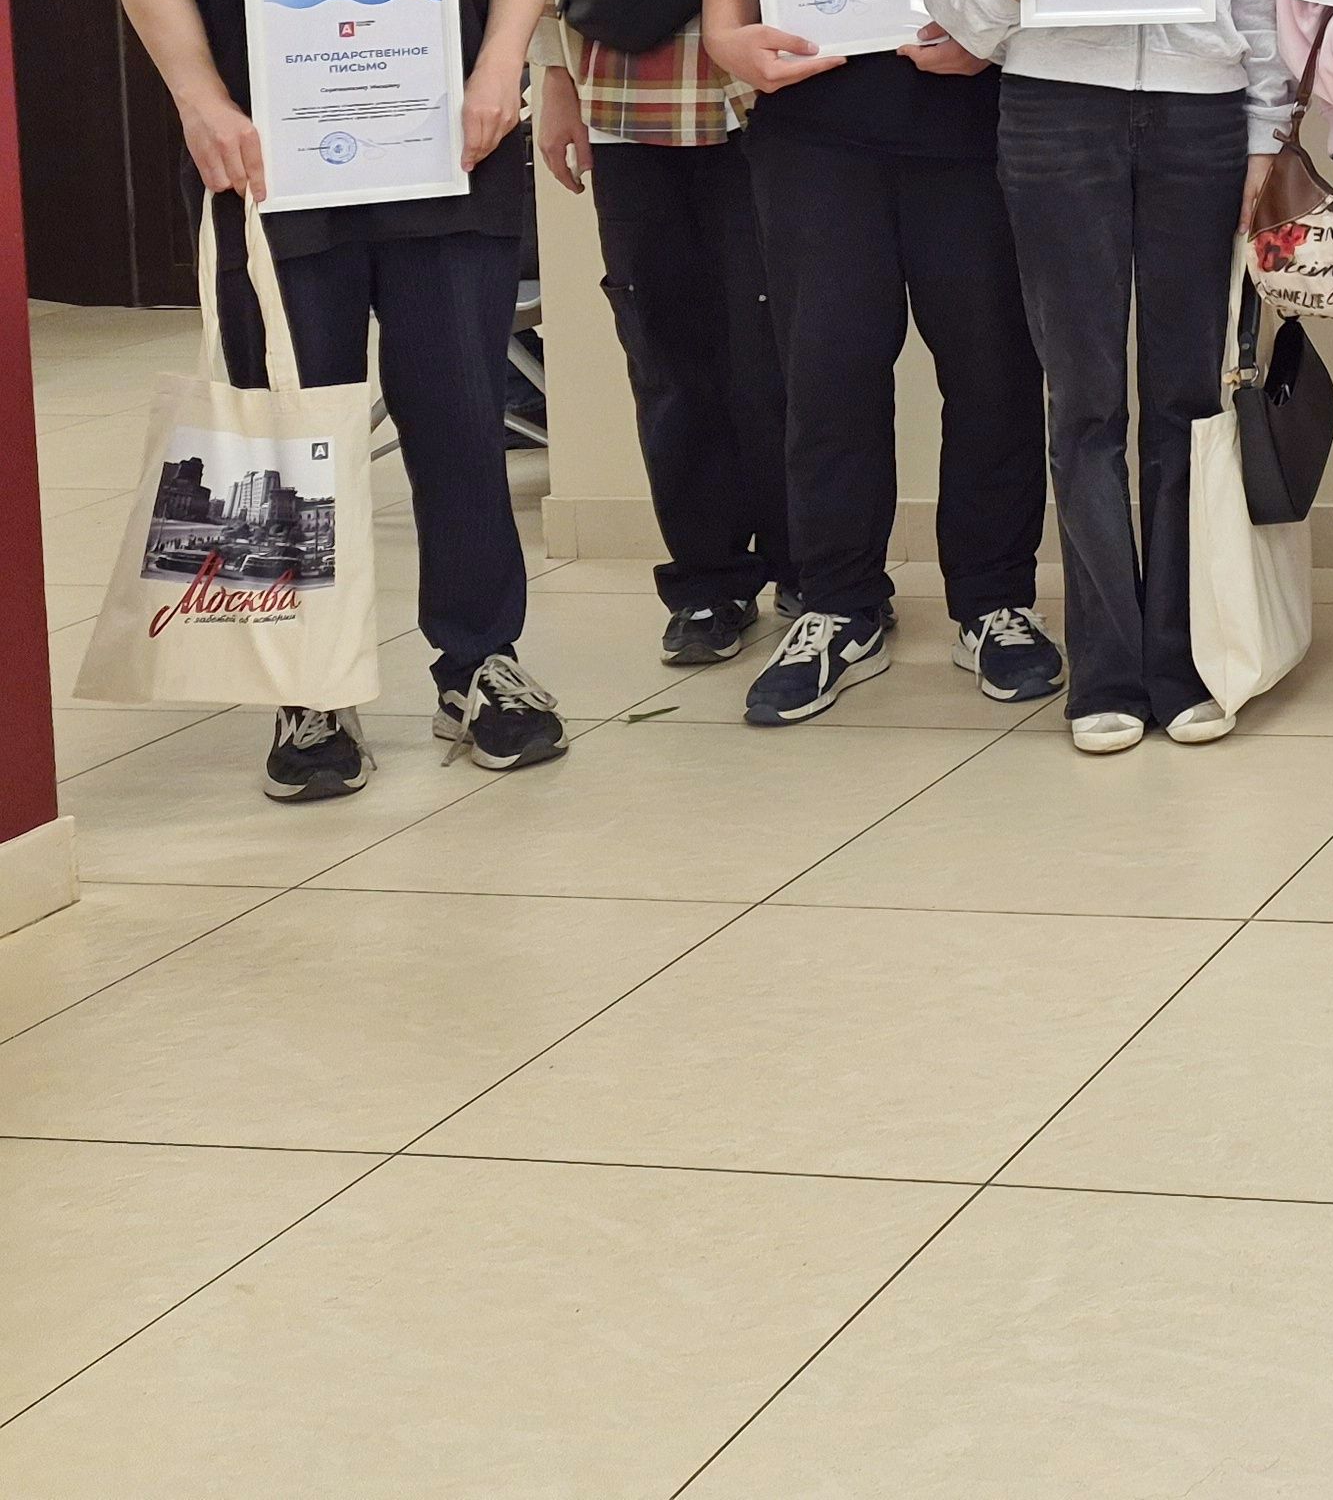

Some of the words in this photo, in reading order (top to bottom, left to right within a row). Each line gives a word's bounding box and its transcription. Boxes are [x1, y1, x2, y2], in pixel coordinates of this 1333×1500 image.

[285, 46, 429, 65] БЛАГОДАРСТВЕННОЕ
[329, 61, 387, 74] ПИСЬМО
[149, 548, 302, 638] Москва
